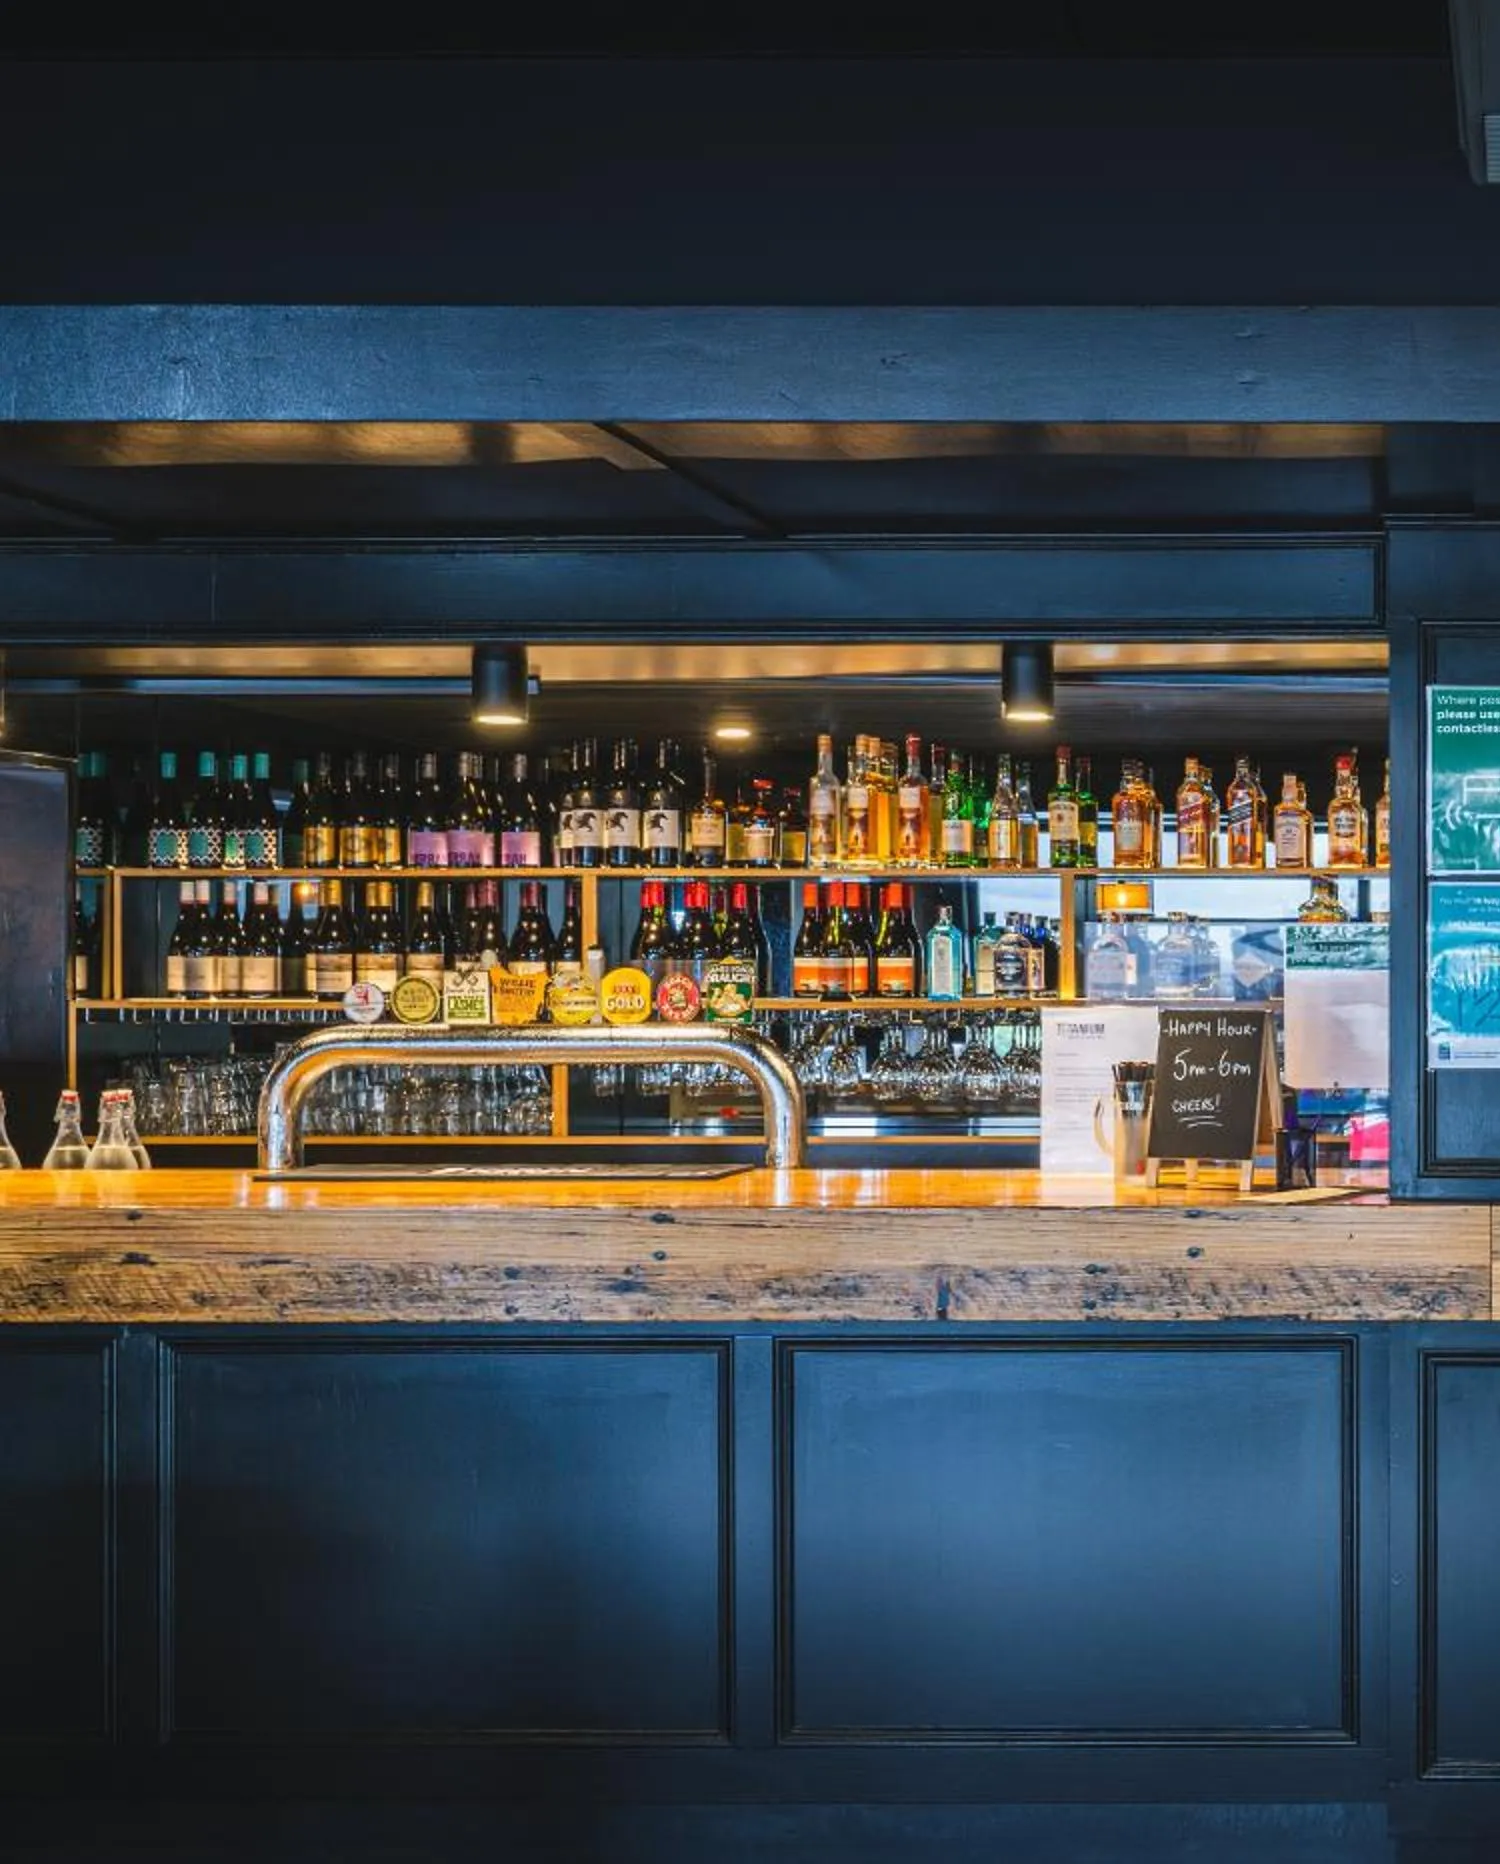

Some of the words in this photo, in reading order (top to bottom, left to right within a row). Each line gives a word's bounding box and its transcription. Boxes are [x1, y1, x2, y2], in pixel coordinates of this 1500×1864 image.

[1437, 695, 1476, 705] Where
[1436, 709, 1476, 720] please
[1479, 711, 1500, 719] use
